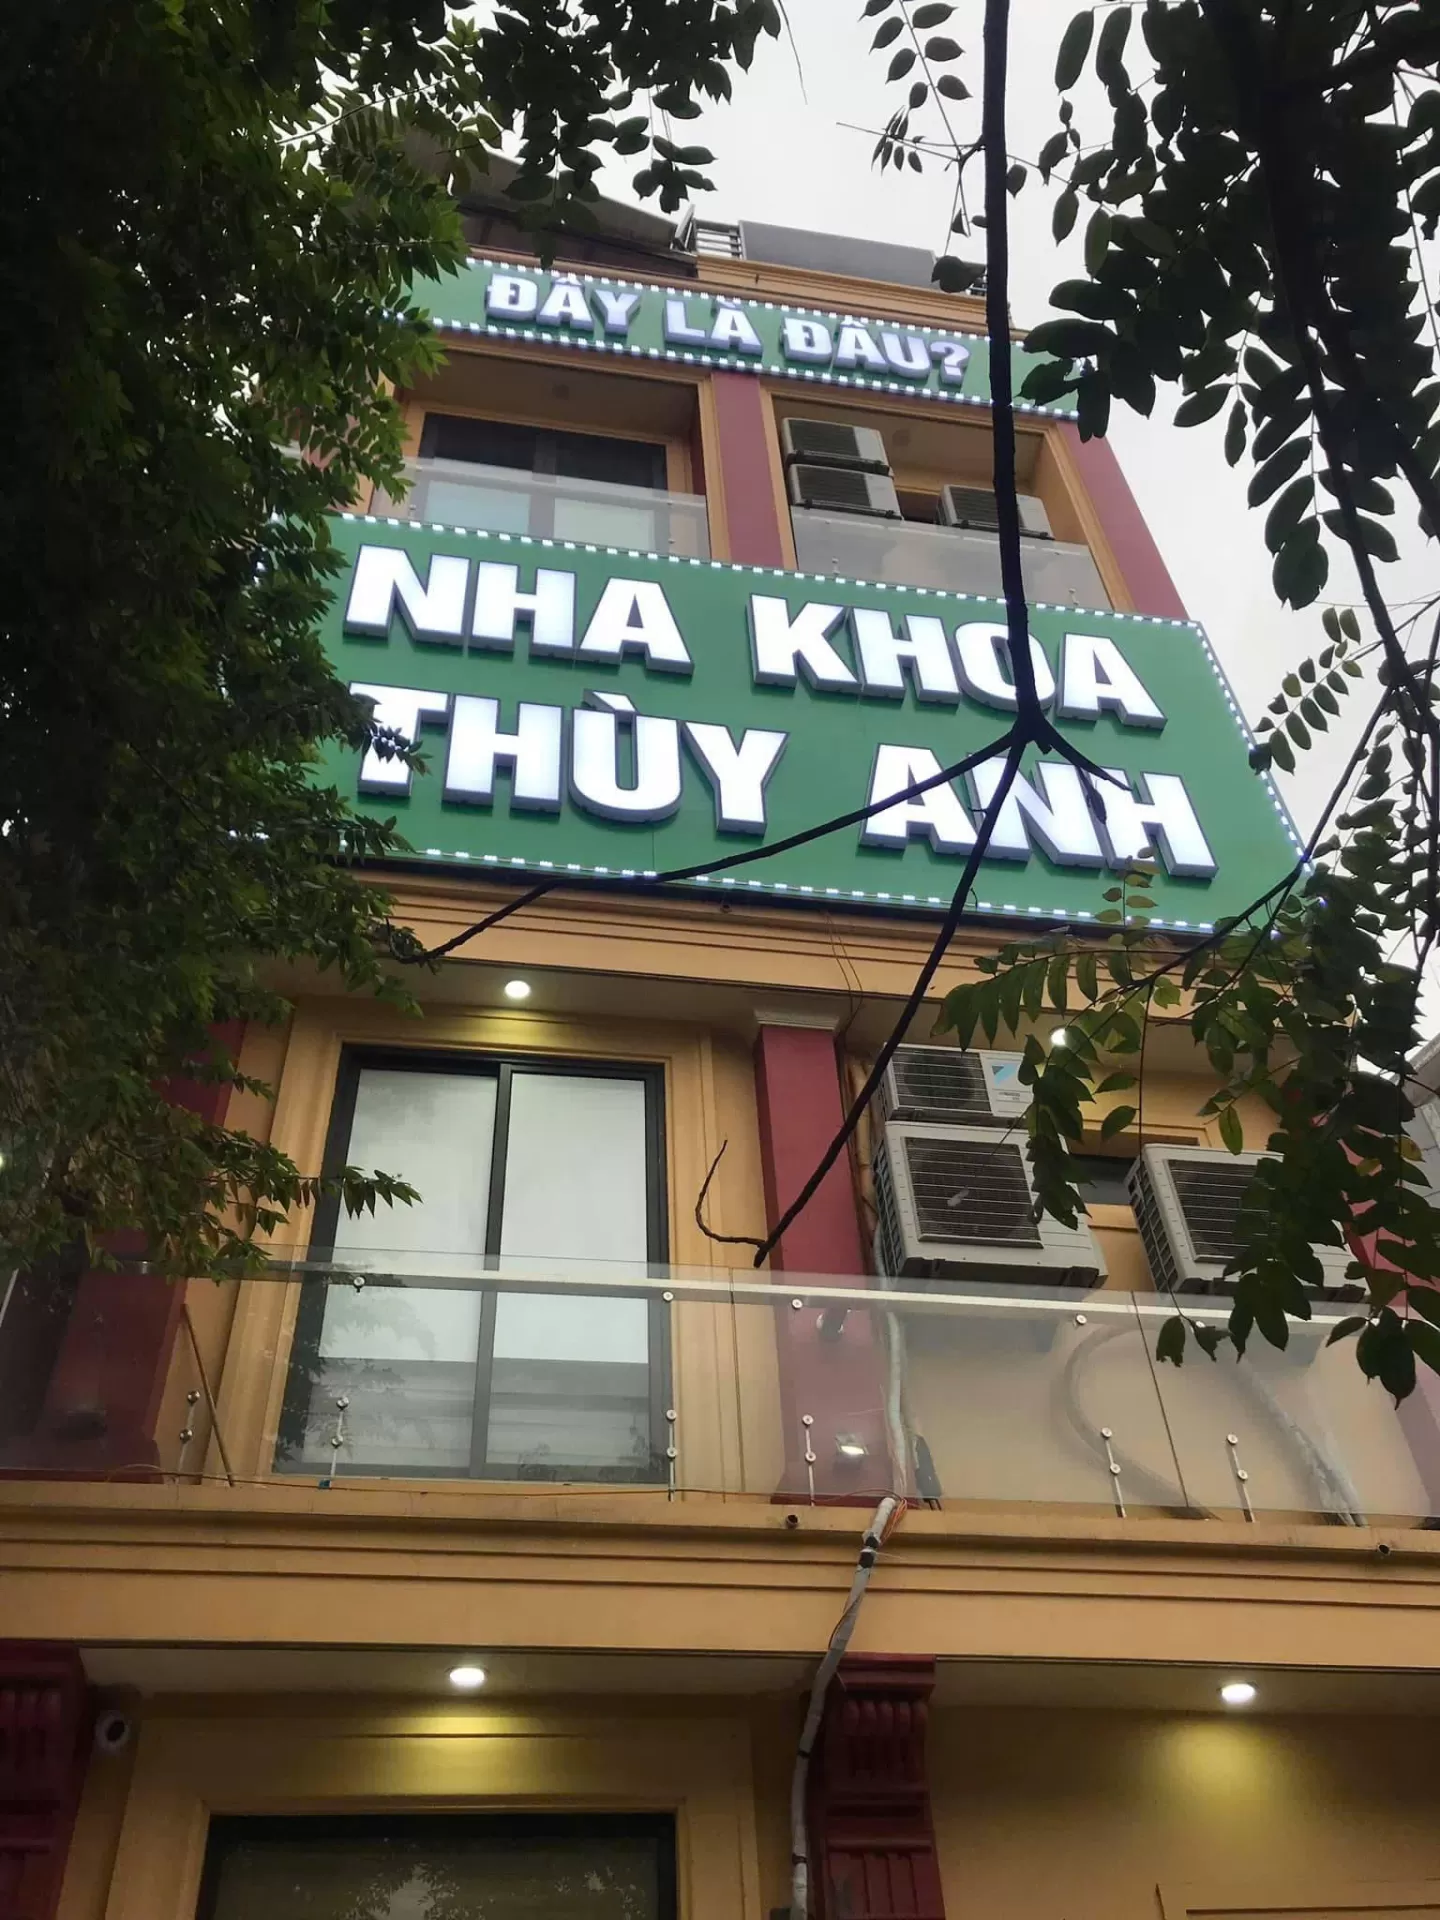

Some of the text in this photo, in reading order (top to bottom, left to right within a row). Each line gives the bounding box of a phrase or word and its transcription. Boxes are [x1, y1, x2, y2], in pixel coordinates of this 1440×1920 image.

[486, 274, 970, 385] ĐÂY LÀ ĐÂU?
[343, 544, 1168, 731] NHA KHOA
[348, 681, 1218, 878] THÙY ANH
